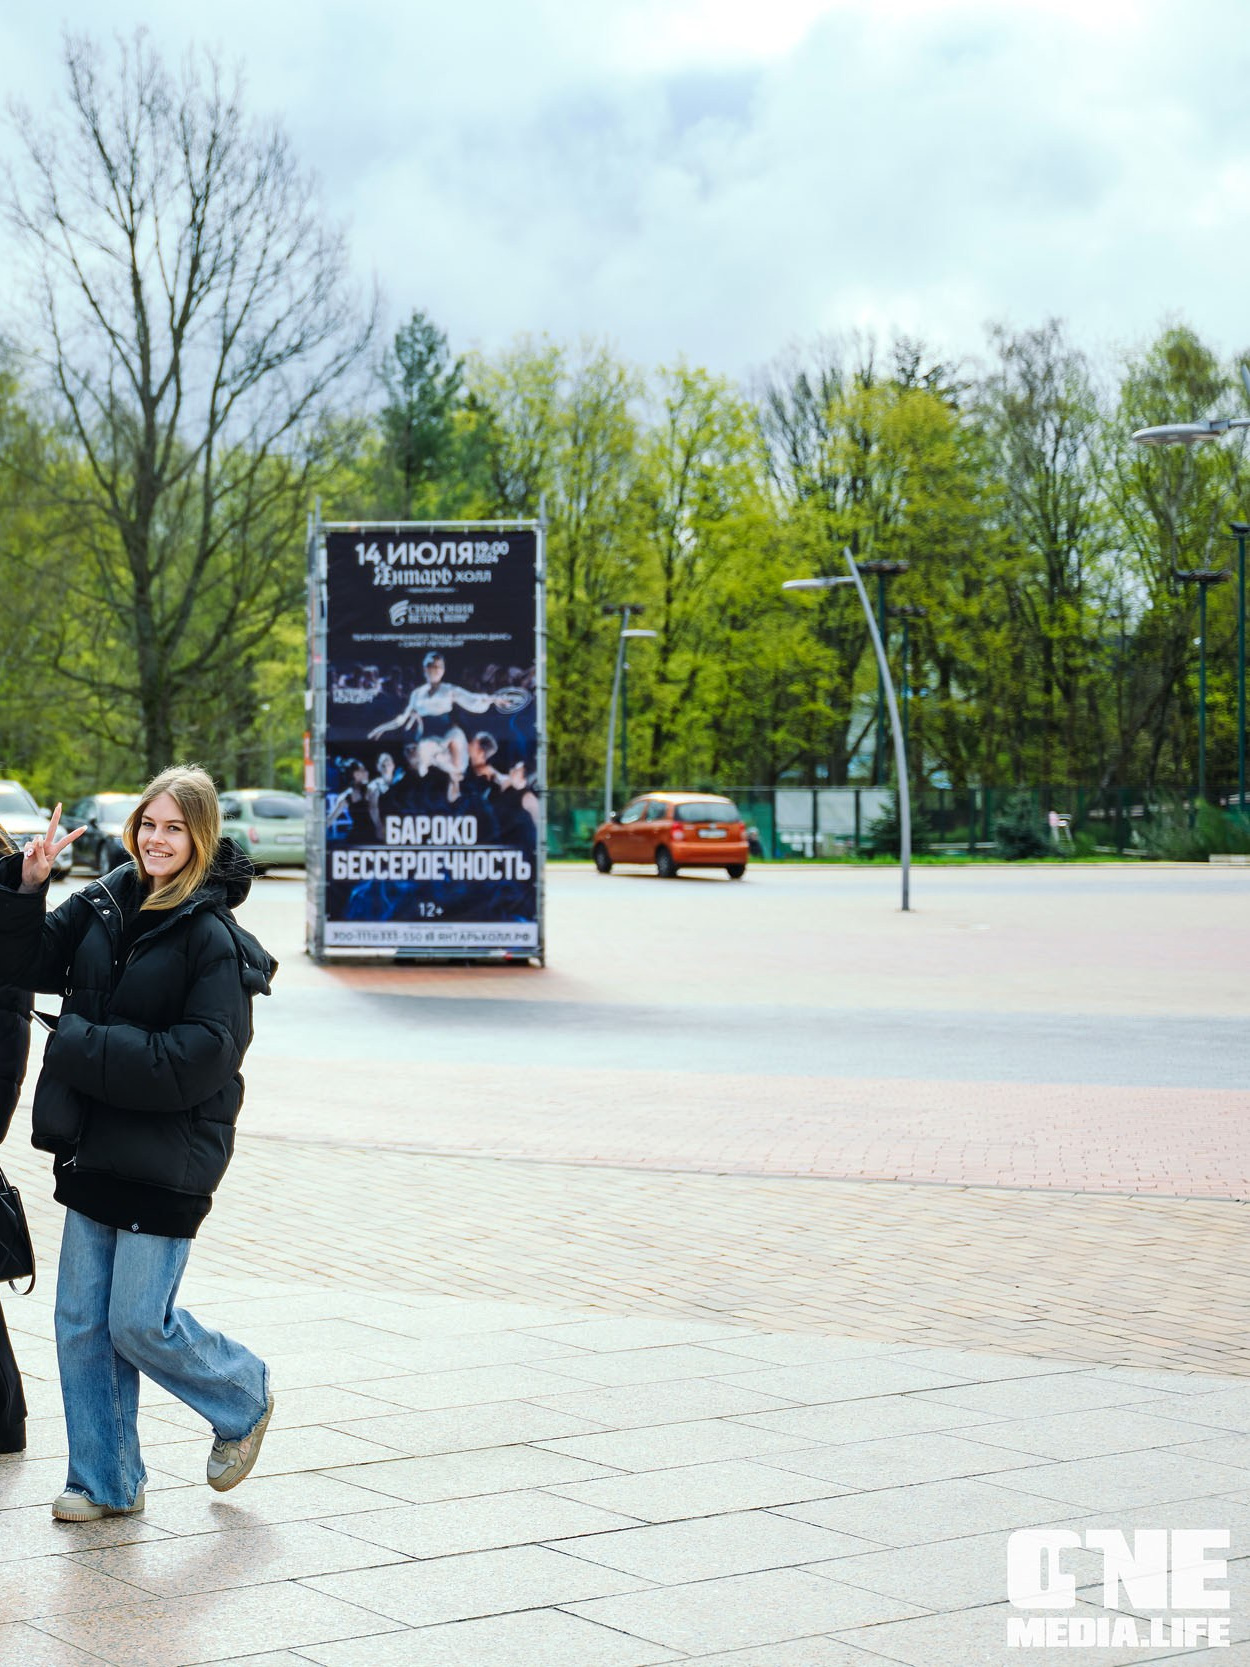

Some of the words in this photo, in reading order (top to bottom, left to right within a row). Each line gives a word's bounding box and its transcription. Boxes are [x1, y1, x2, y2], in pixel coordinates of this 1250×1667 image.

[355, 542, 382, 565] 14
[387, 541, 474, 565] ИЮЛЯ
[332, 850, 532, 880] БЕССЕРДЕЧНОСТЬ
[418, 902, 444, 917] 12+
